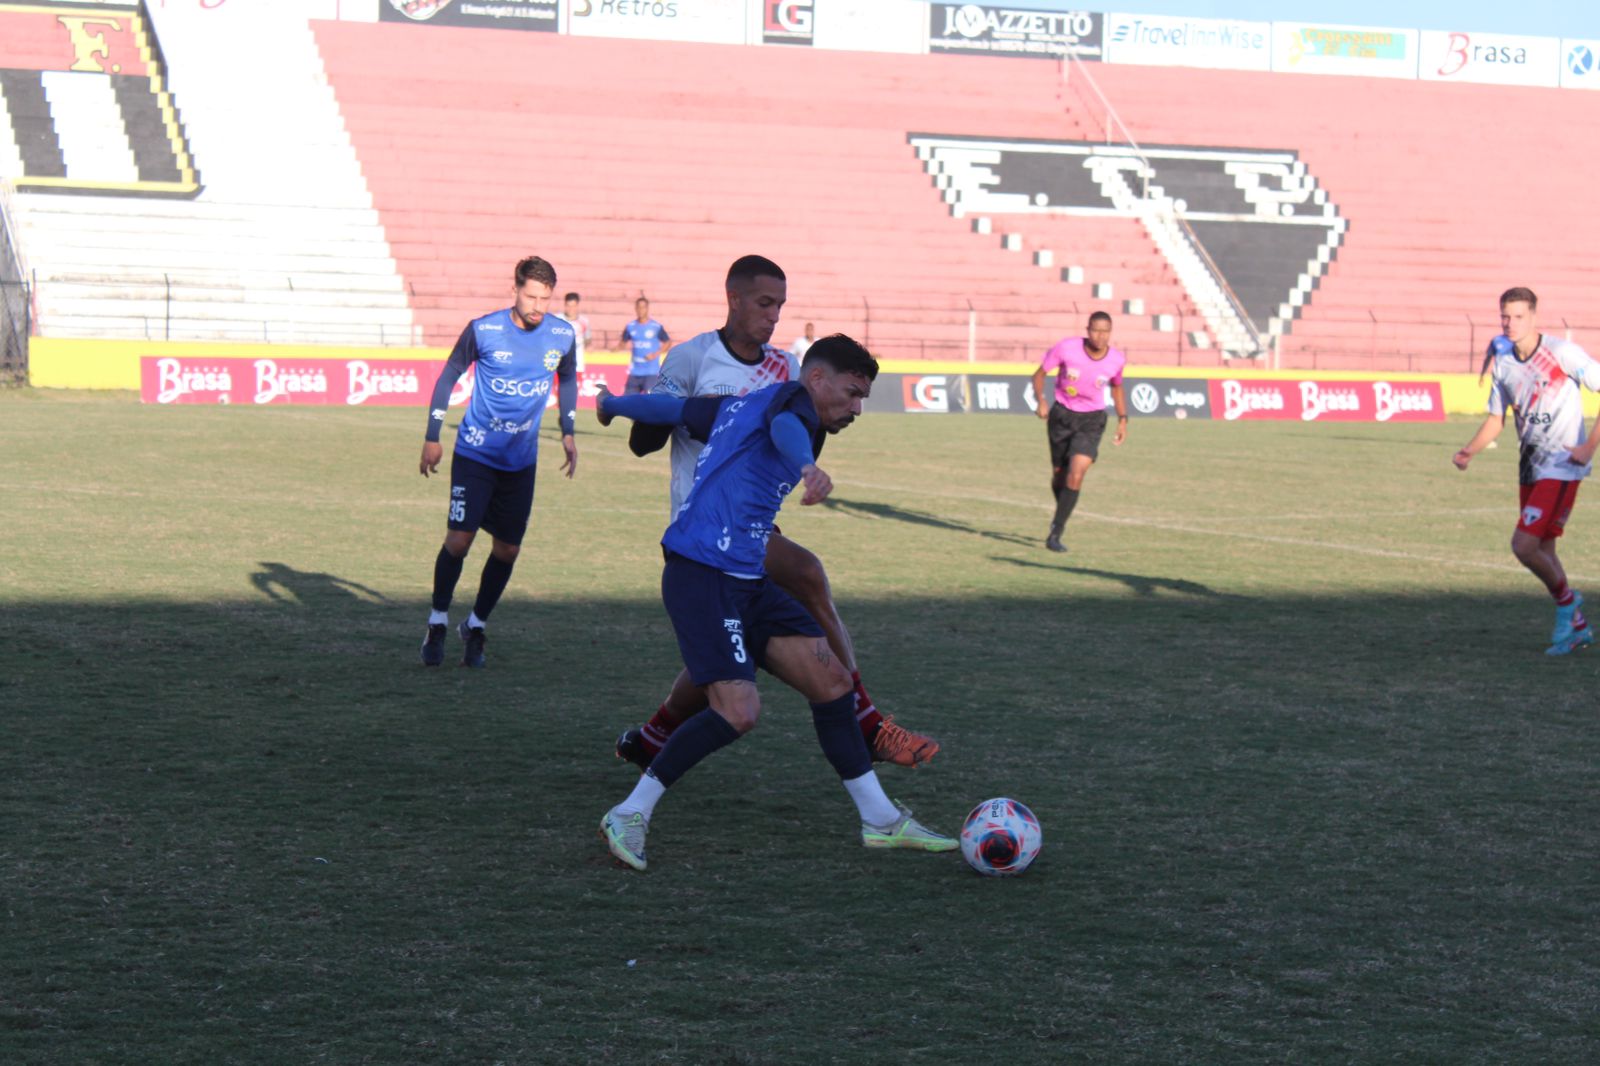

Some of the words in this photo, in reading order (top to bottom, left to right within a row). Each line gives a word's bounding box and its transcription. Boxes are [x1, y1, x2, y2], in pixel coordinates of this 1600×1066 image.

[1436, 32, 1527, 76] Brasa
[157, 358, 232, 404] Brasa
[253, 359, 327, 405] Brasa
[346, 360, 418, 405] Brasa
[1164, 389, 1206, 408] Jeep
[1222, 380, 1284, 420] Brasa
[1299, 381, 1360, 421] Brasa
[1373, 381, 1433, 421] Brasa
[465, 426, 486, 446] 35
[449, 500, 466, 523] 35
[731, 634, 747, 663] 3
